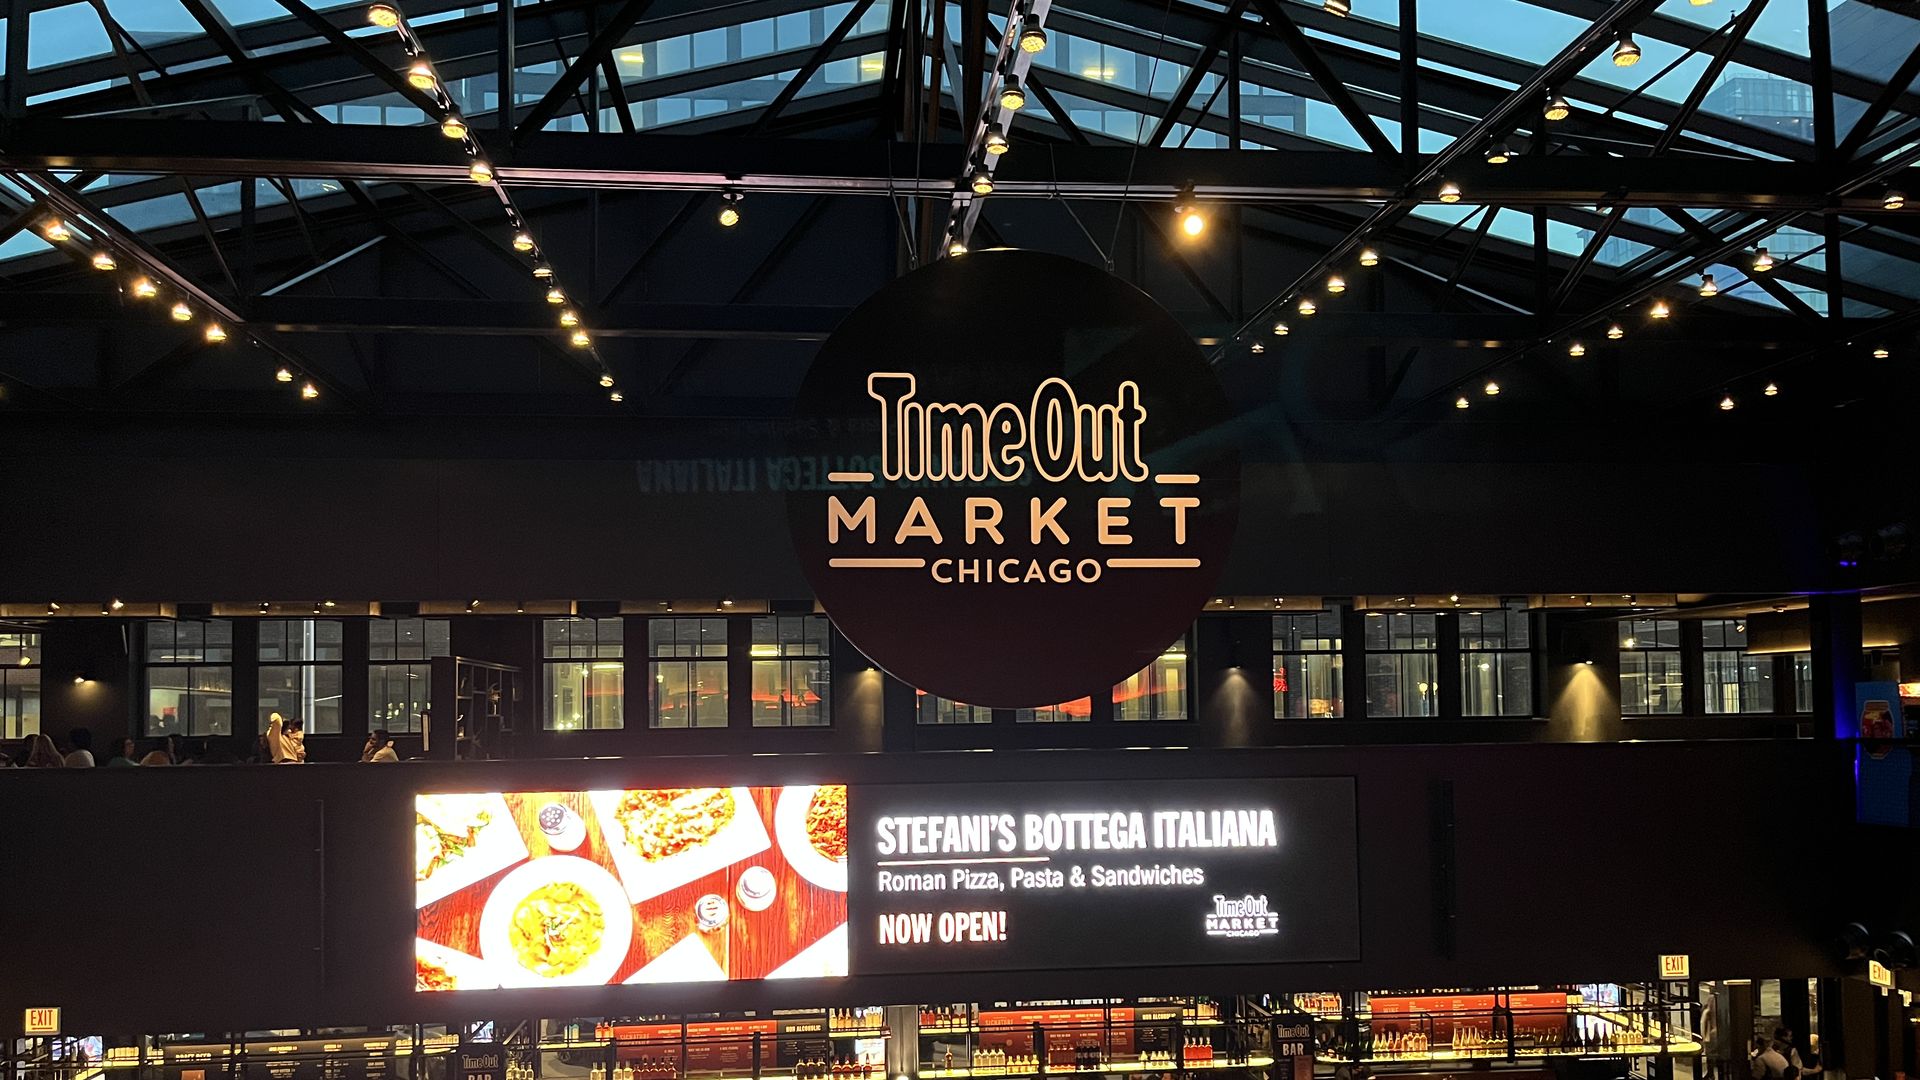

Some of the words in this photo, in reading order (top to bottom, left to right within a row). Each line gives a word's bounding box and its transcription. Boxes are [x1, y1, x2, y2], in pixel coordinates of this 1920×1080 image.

[867, 372, 1026, 482] Time
[1030, 377, 1149, 482] Out
[828, 496, 1200, 545] MARKET
[931, 558, 1102, 584] CHICAGO
[877, 814, 1017, 855] STEFANI'S
[1024, 812, 1147, 851] BOTTEGA
[1154, 810, 1277, 848] ITALIANA
[879, 871, 946, 892] Roman
[952, 869, 1004, 892] Pizza,
[1011, 867, 1063, 888] Pasta
[1070, 866, 1086, 887] &
[1091, 864, 1204, 887] Sandwiches
[1213, 895, 1244, 917] Time
[1244, 895, 1268, 917] Out
[879, 913, 932, 944] NOW
[938, 911, 1007, 942] OPEN!
[1206, 917, 1278, 930] MARKET
[1665, 957, 1684, 971] EXIT
[31, 1010, 53, 1026] EXIT
[1276, 1024, 1295, 1038] Time
[1295, 1024, 1310, 1038] Out
[1282, 1043, 1304, 1056] BAR
[462, 1054, 483, 1068] Time
[483, 1054, 498, 1068] Out
